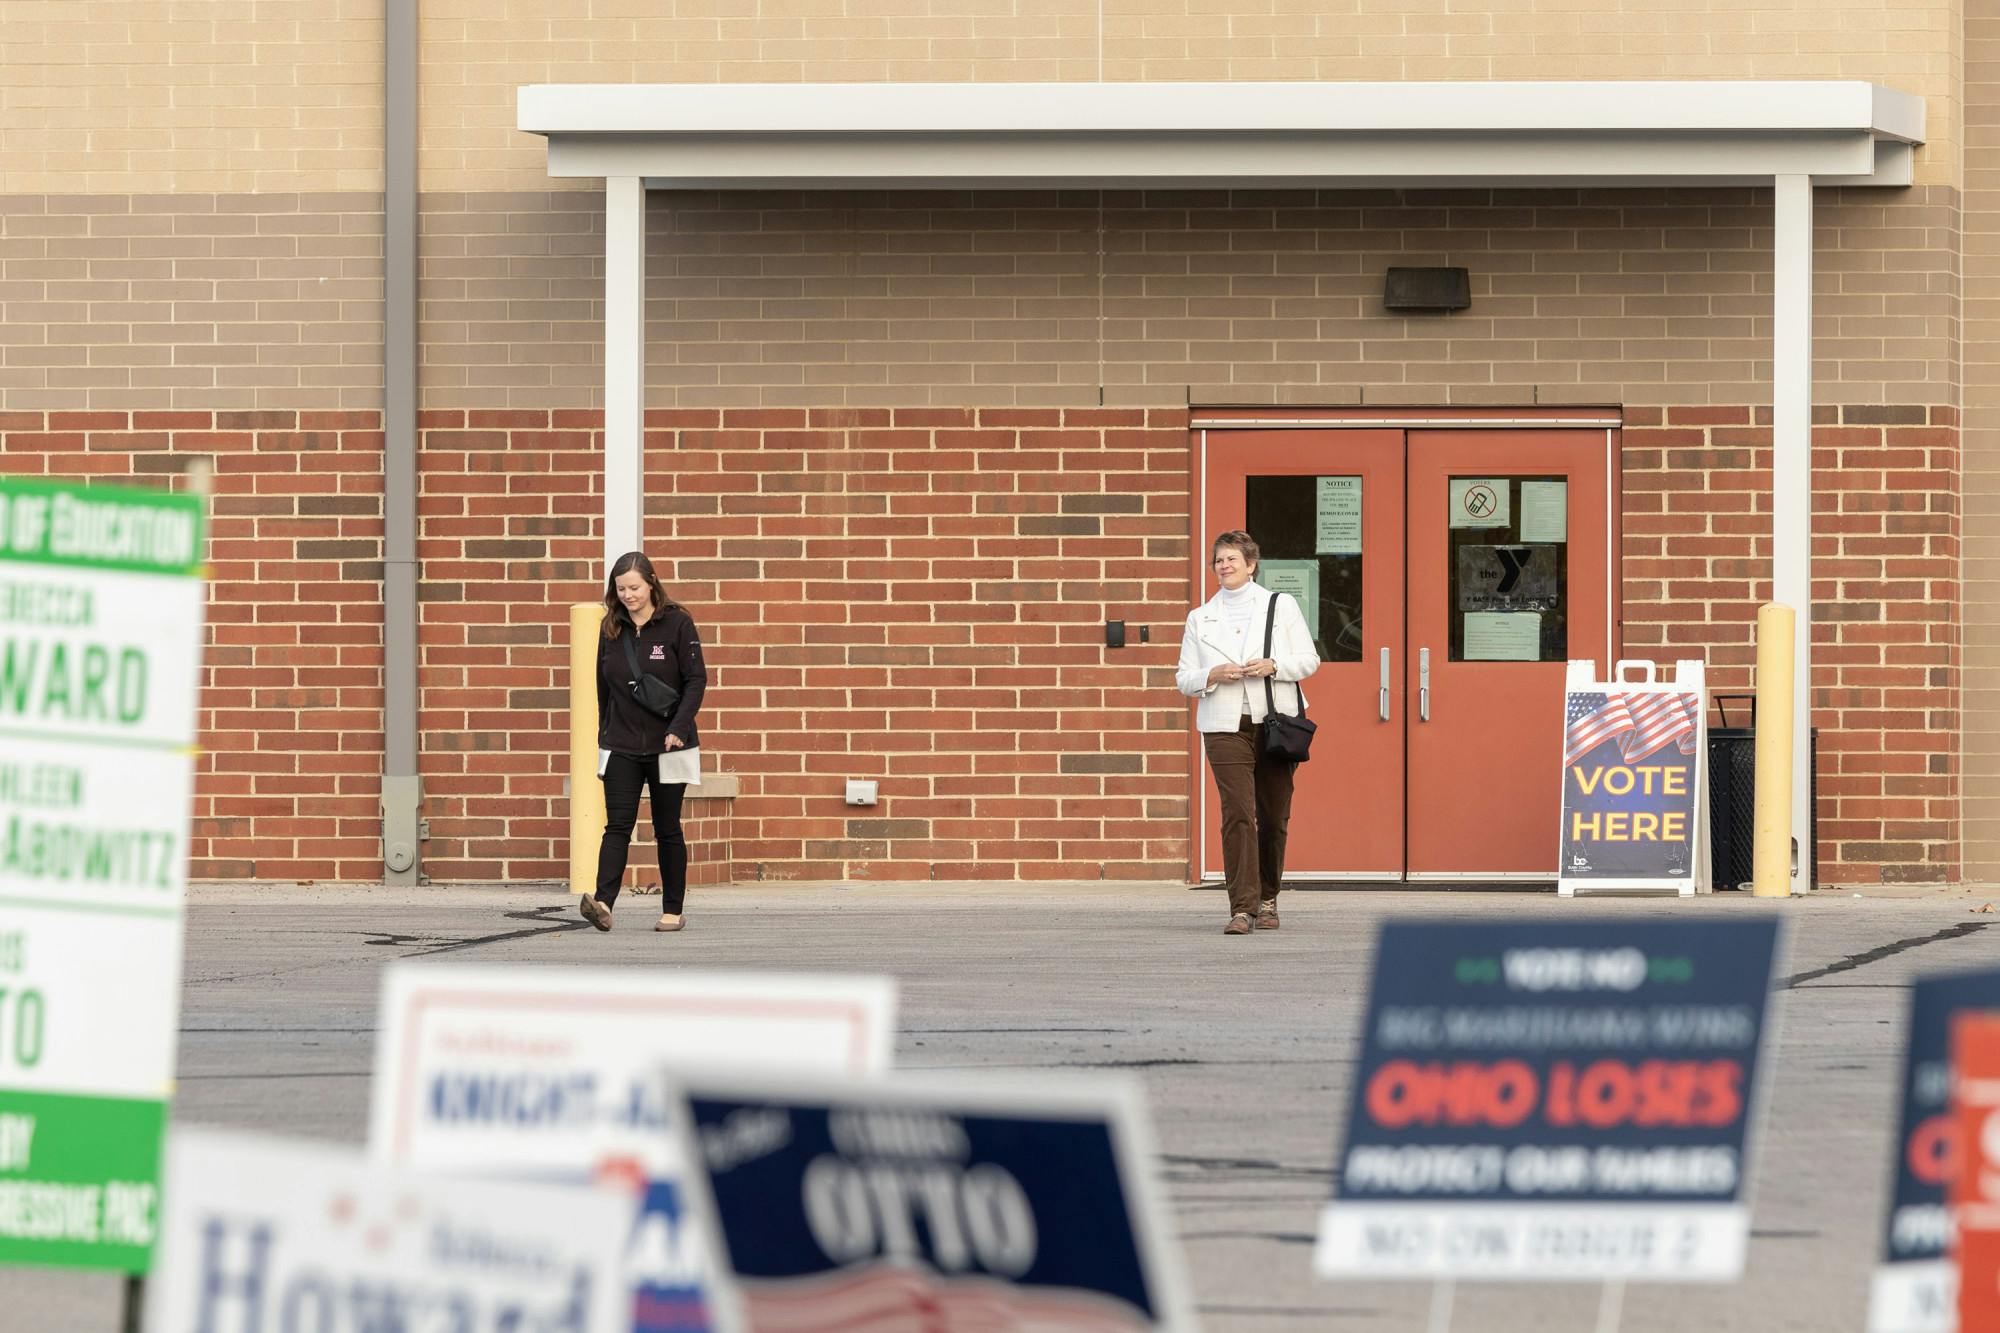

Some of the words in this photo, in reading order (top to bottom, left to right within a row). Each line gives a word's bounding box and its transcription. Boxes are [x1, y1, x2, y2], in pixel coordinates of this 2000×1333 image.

[1479, 569, 1498, 579] the
[1573, 765, 1687, 795] VOTE
[1572, 812, 1686, 841] HERE
[1365, 1058, 1539, 1128] OHIO
[1545, 1058, 1741, 1128] LOSES
[1344, 1145, 1503, 1192] PROTECT
[1592, 1145, 1737, 1192] FAMILIES
[803, 1153, 1038, 1277] OTTO
